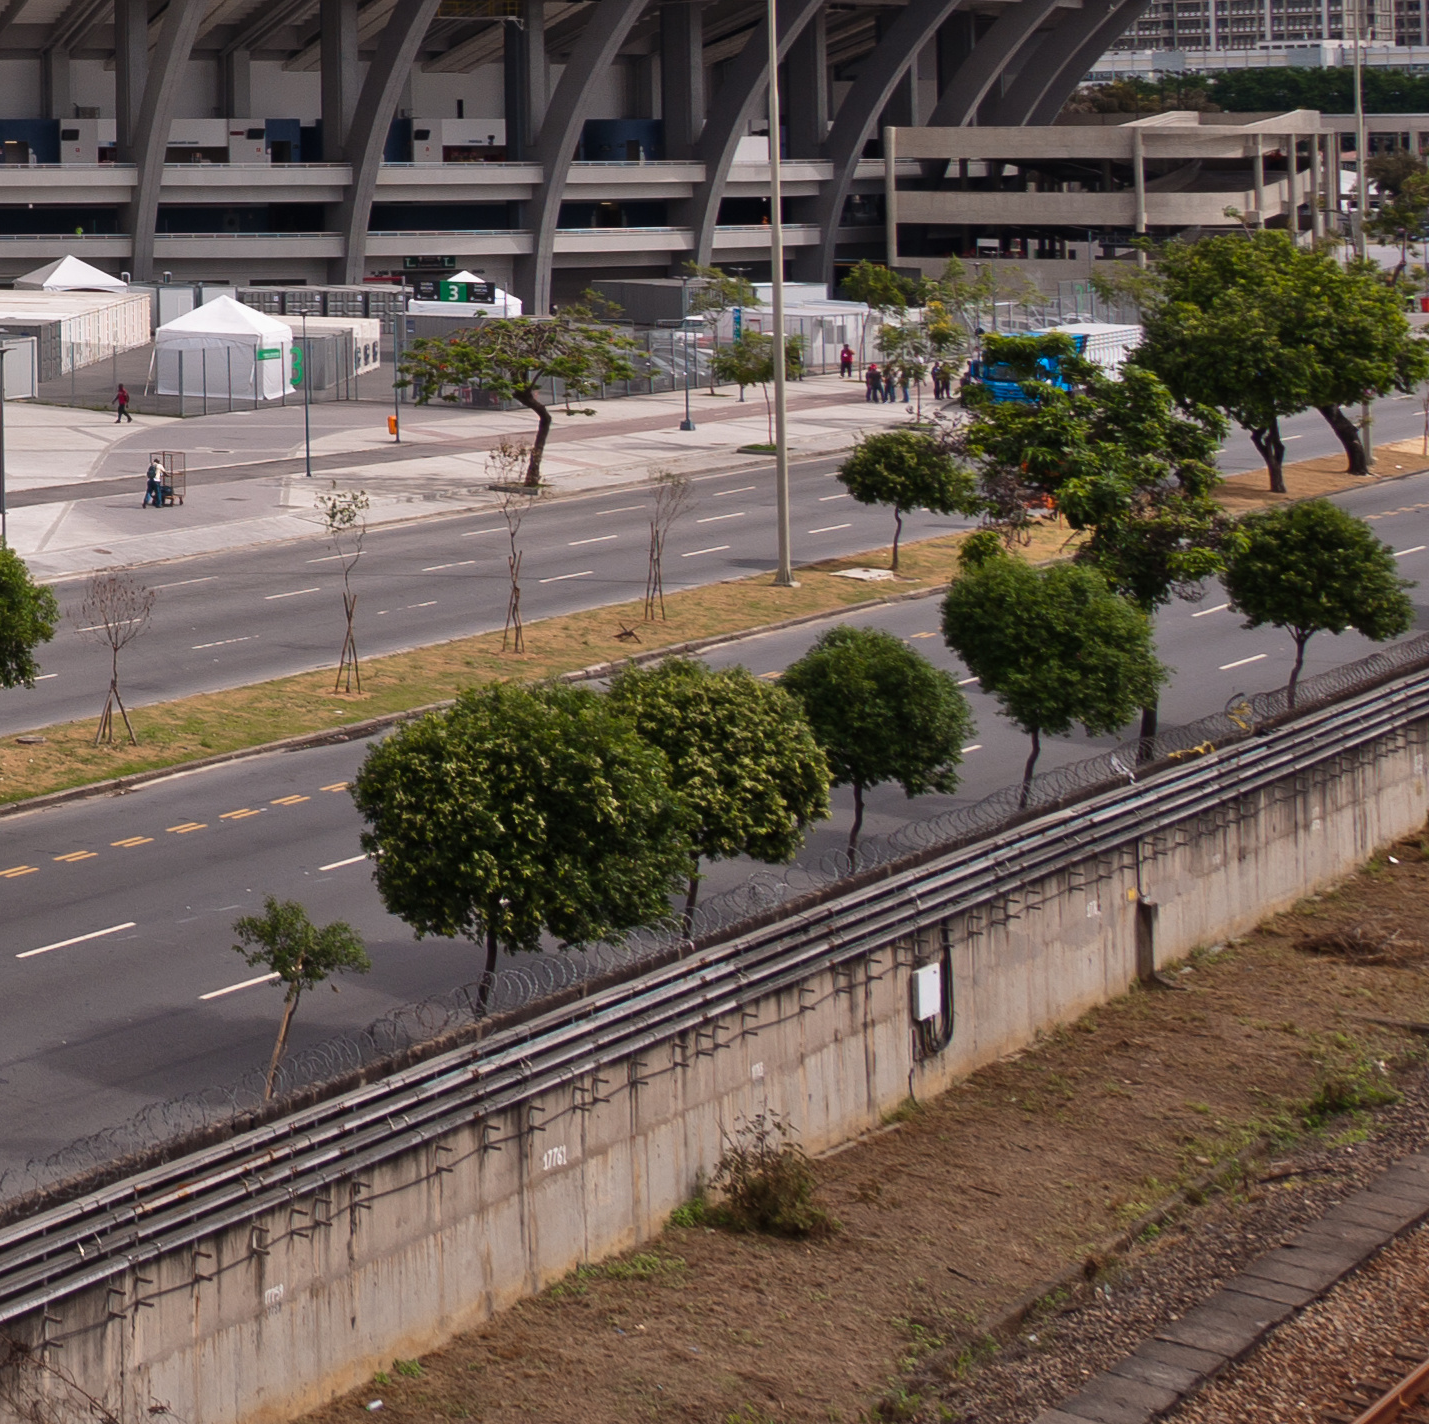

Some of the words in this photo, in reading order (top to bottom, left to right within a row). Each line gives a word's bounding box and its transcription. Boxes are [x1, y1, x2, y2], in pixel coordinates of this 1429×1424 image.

[448, 285, 460, 301] 3
[289, 346, 304, 386] 3
[543, 1144, 567, 1170] 17761
